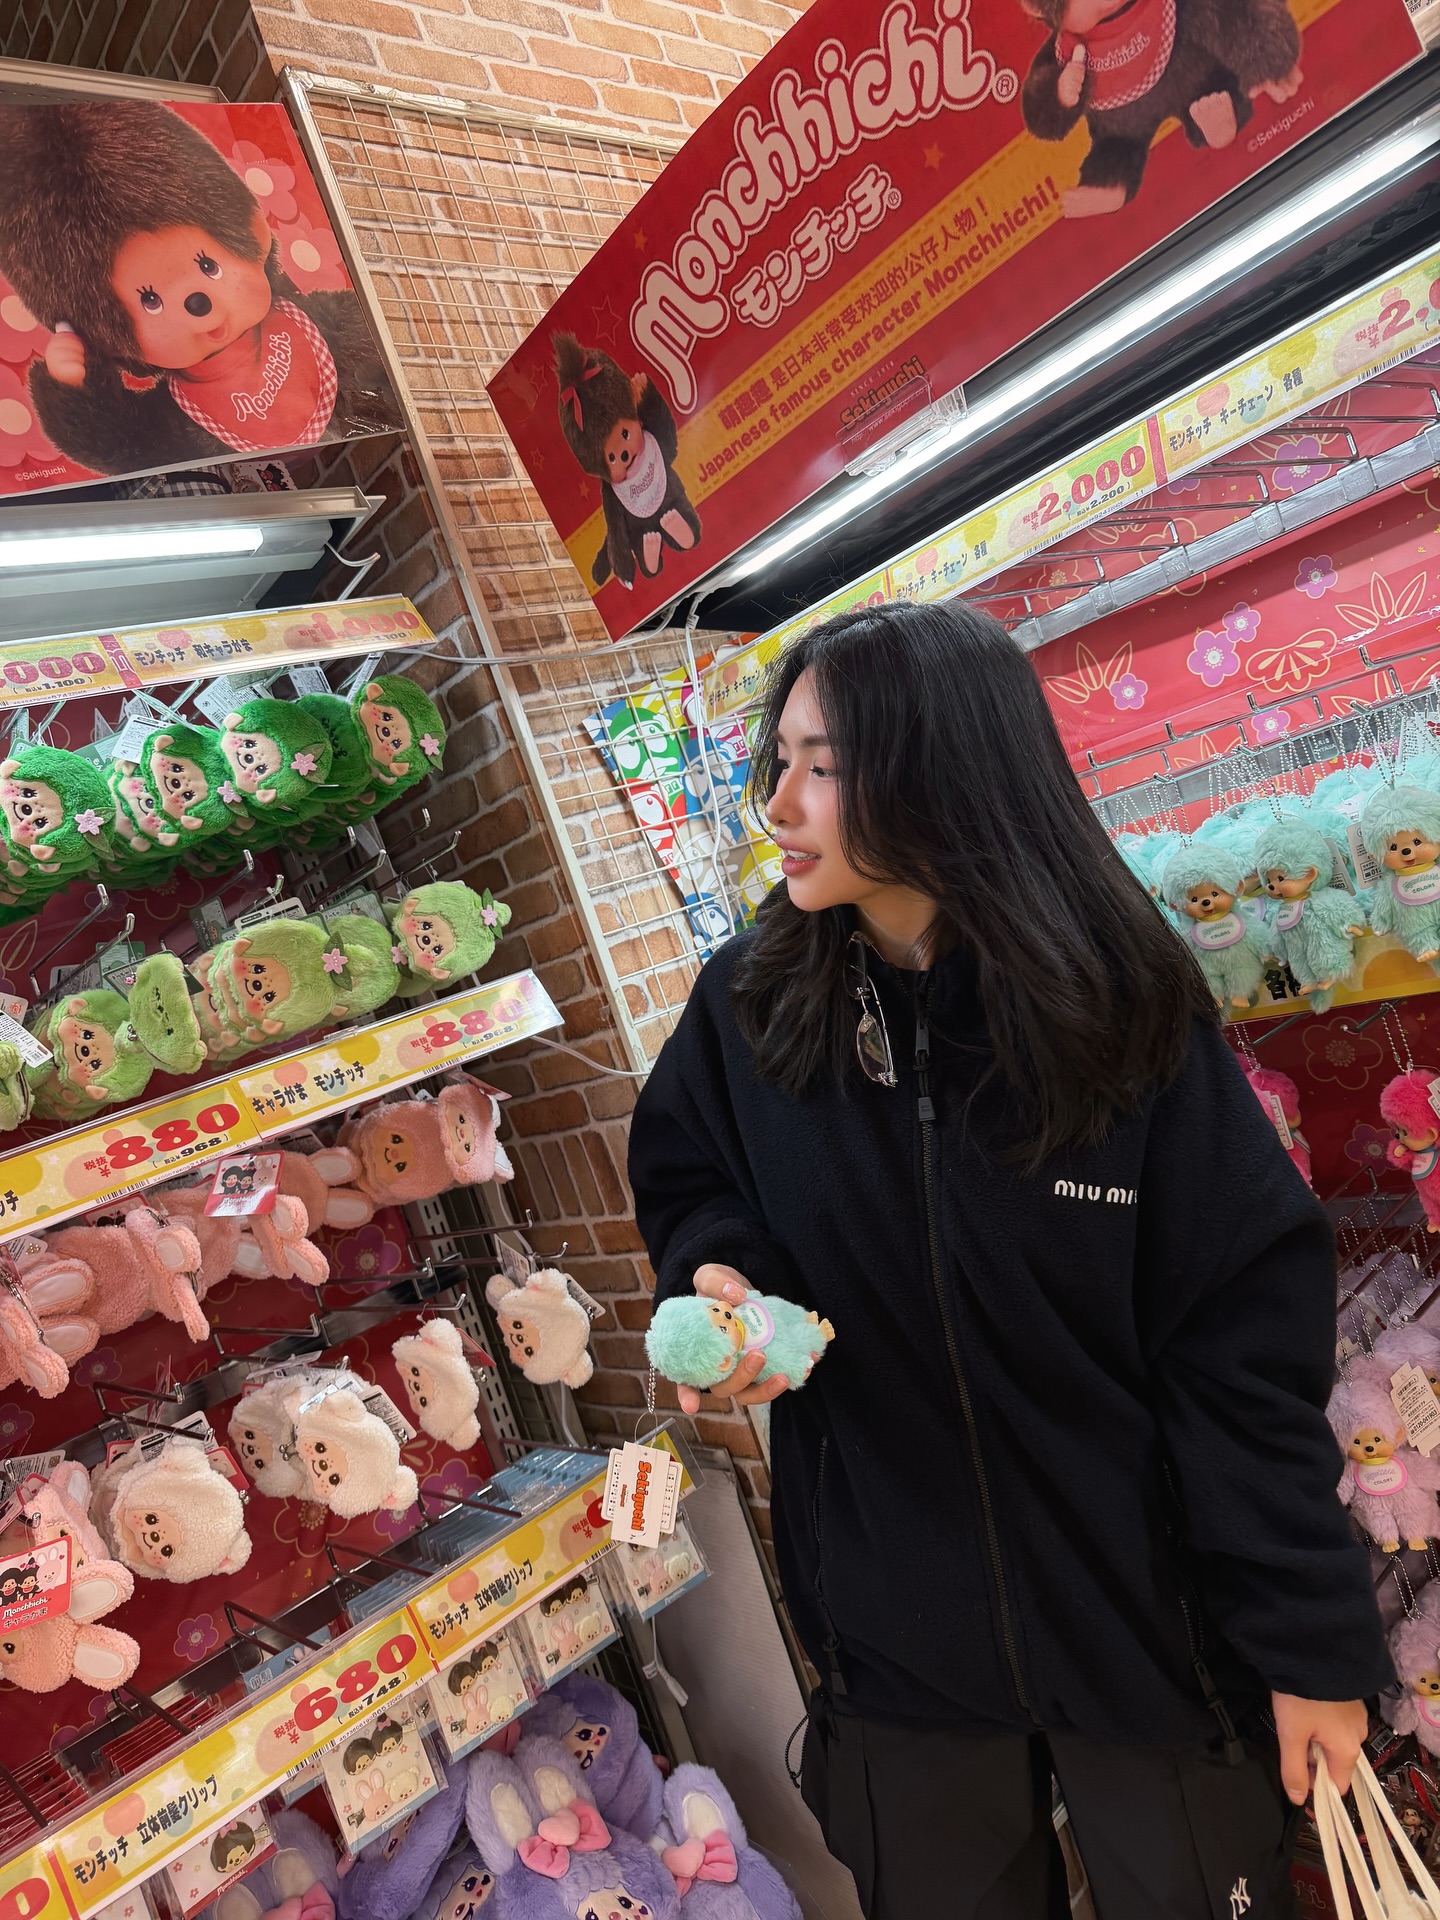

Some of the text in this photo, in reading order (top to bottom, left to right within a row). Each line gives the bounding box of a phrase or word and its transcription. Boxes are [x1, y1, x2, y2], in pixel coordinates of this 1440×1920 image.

[630, 0, 996, 414] Monchhichi
[731, 164, 893, 328] モンチッチ
[699, 176, 1059, 483] Japanese famous character Monchhichi!
[231, 331, 292, 422] Monchhichi
[840, 355, 925, 431] Sekiguchi
[1169, 417, 1212, 451] モンチッチ
[1219, 384, 1274, 425] キーチェーン
[135, 649, 186, 667] モンチッチ
[252, 1061, 364, 1115] キャラがま モンチッチ
[84, 1156, 107, 1171] 税抜
[631, 1461, 652, 1532] Sekiguchi
[2, 1597, 48, 1620] Monchhichi
[3, 1608, 48, 1629] キャラがま
[429, 1603, 469, 1640] モンチッチ
[273, 1718, 297, 1739] 税抜
[73, 1774, 218, 1885] モンチッチ 立体前髪クリップ
